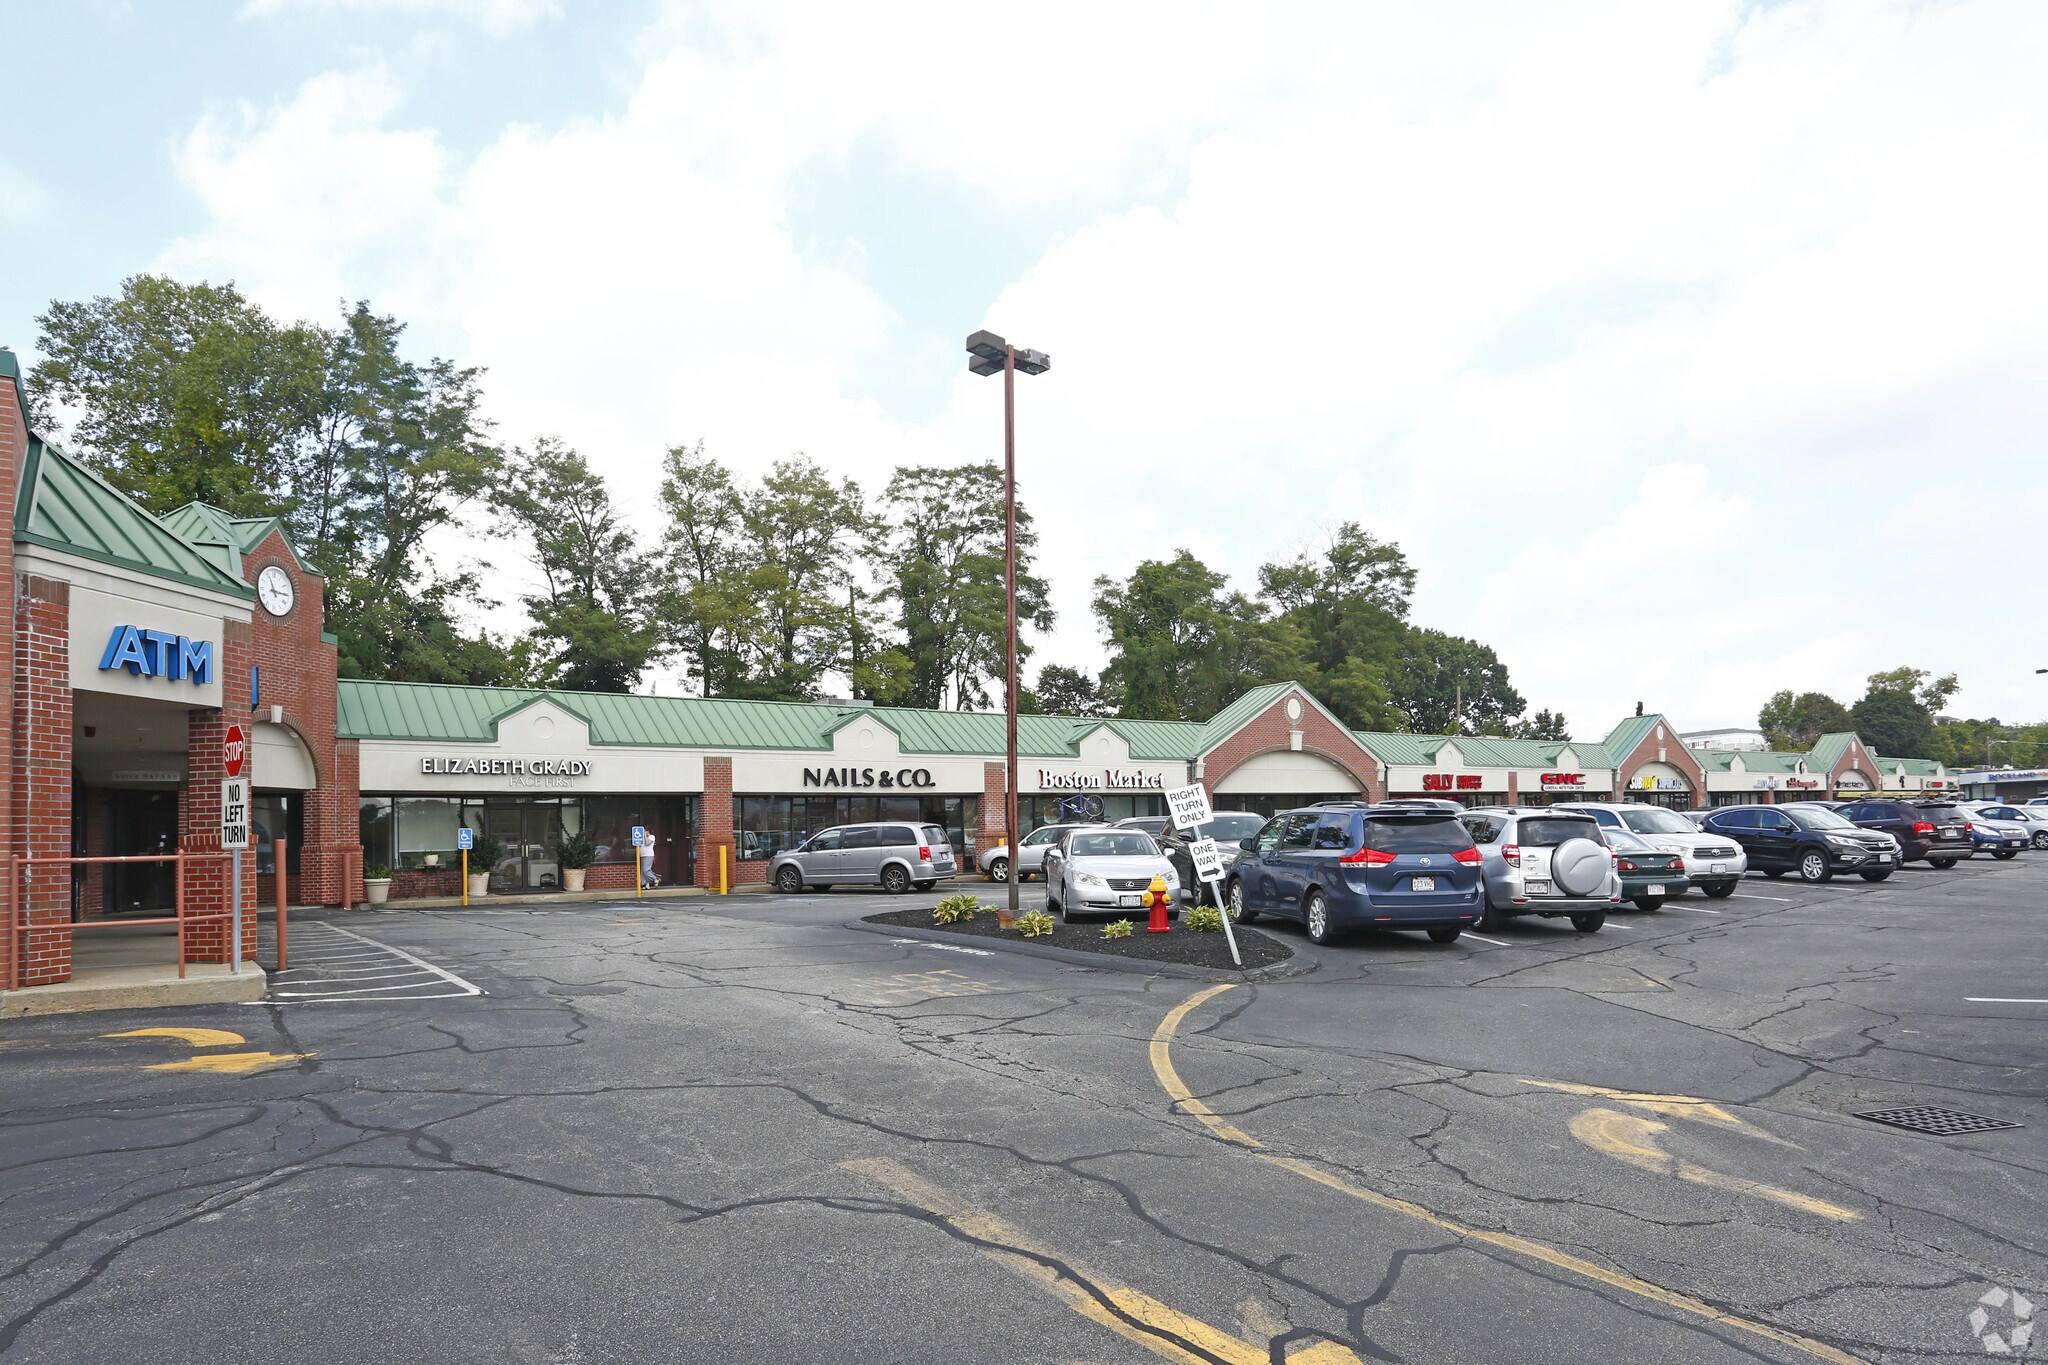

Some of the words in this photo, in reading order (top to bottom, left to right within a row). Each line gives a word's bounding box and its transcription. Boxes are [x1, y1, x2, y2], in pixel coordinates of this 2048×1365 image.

[99, 624, 213, 685] ATM
[225, 740, 243, 762] STOP
[421, 758, 525, 774] ELIZABETH
[529, 760, 592, 775] GRADY
[509, 776, 542, 787] FACE
[545, 777, 576, 787] FIRST
[1039, 769, 1101, 789] Boston
[1105, 769, 1166, 789] Market
[1423, 774, 1453, 790] SALLY
[1541, 773, 1586, 785] GNC
[1629, 776, 1656, 789] SUBWAY
[229, 784, 240, 802] NO
[1169, 787, 1200, 802] RIGHT
[225, 805, 244, 822] LEFT
[1174, 799, 1203, 813] TURN
[1180, 811, 1205, 824] ONLY
[223, 825, 246, 843] TURN
[1193, 843, 1214, 855] ONE
[1196, 854, 1216, 866] WAY
